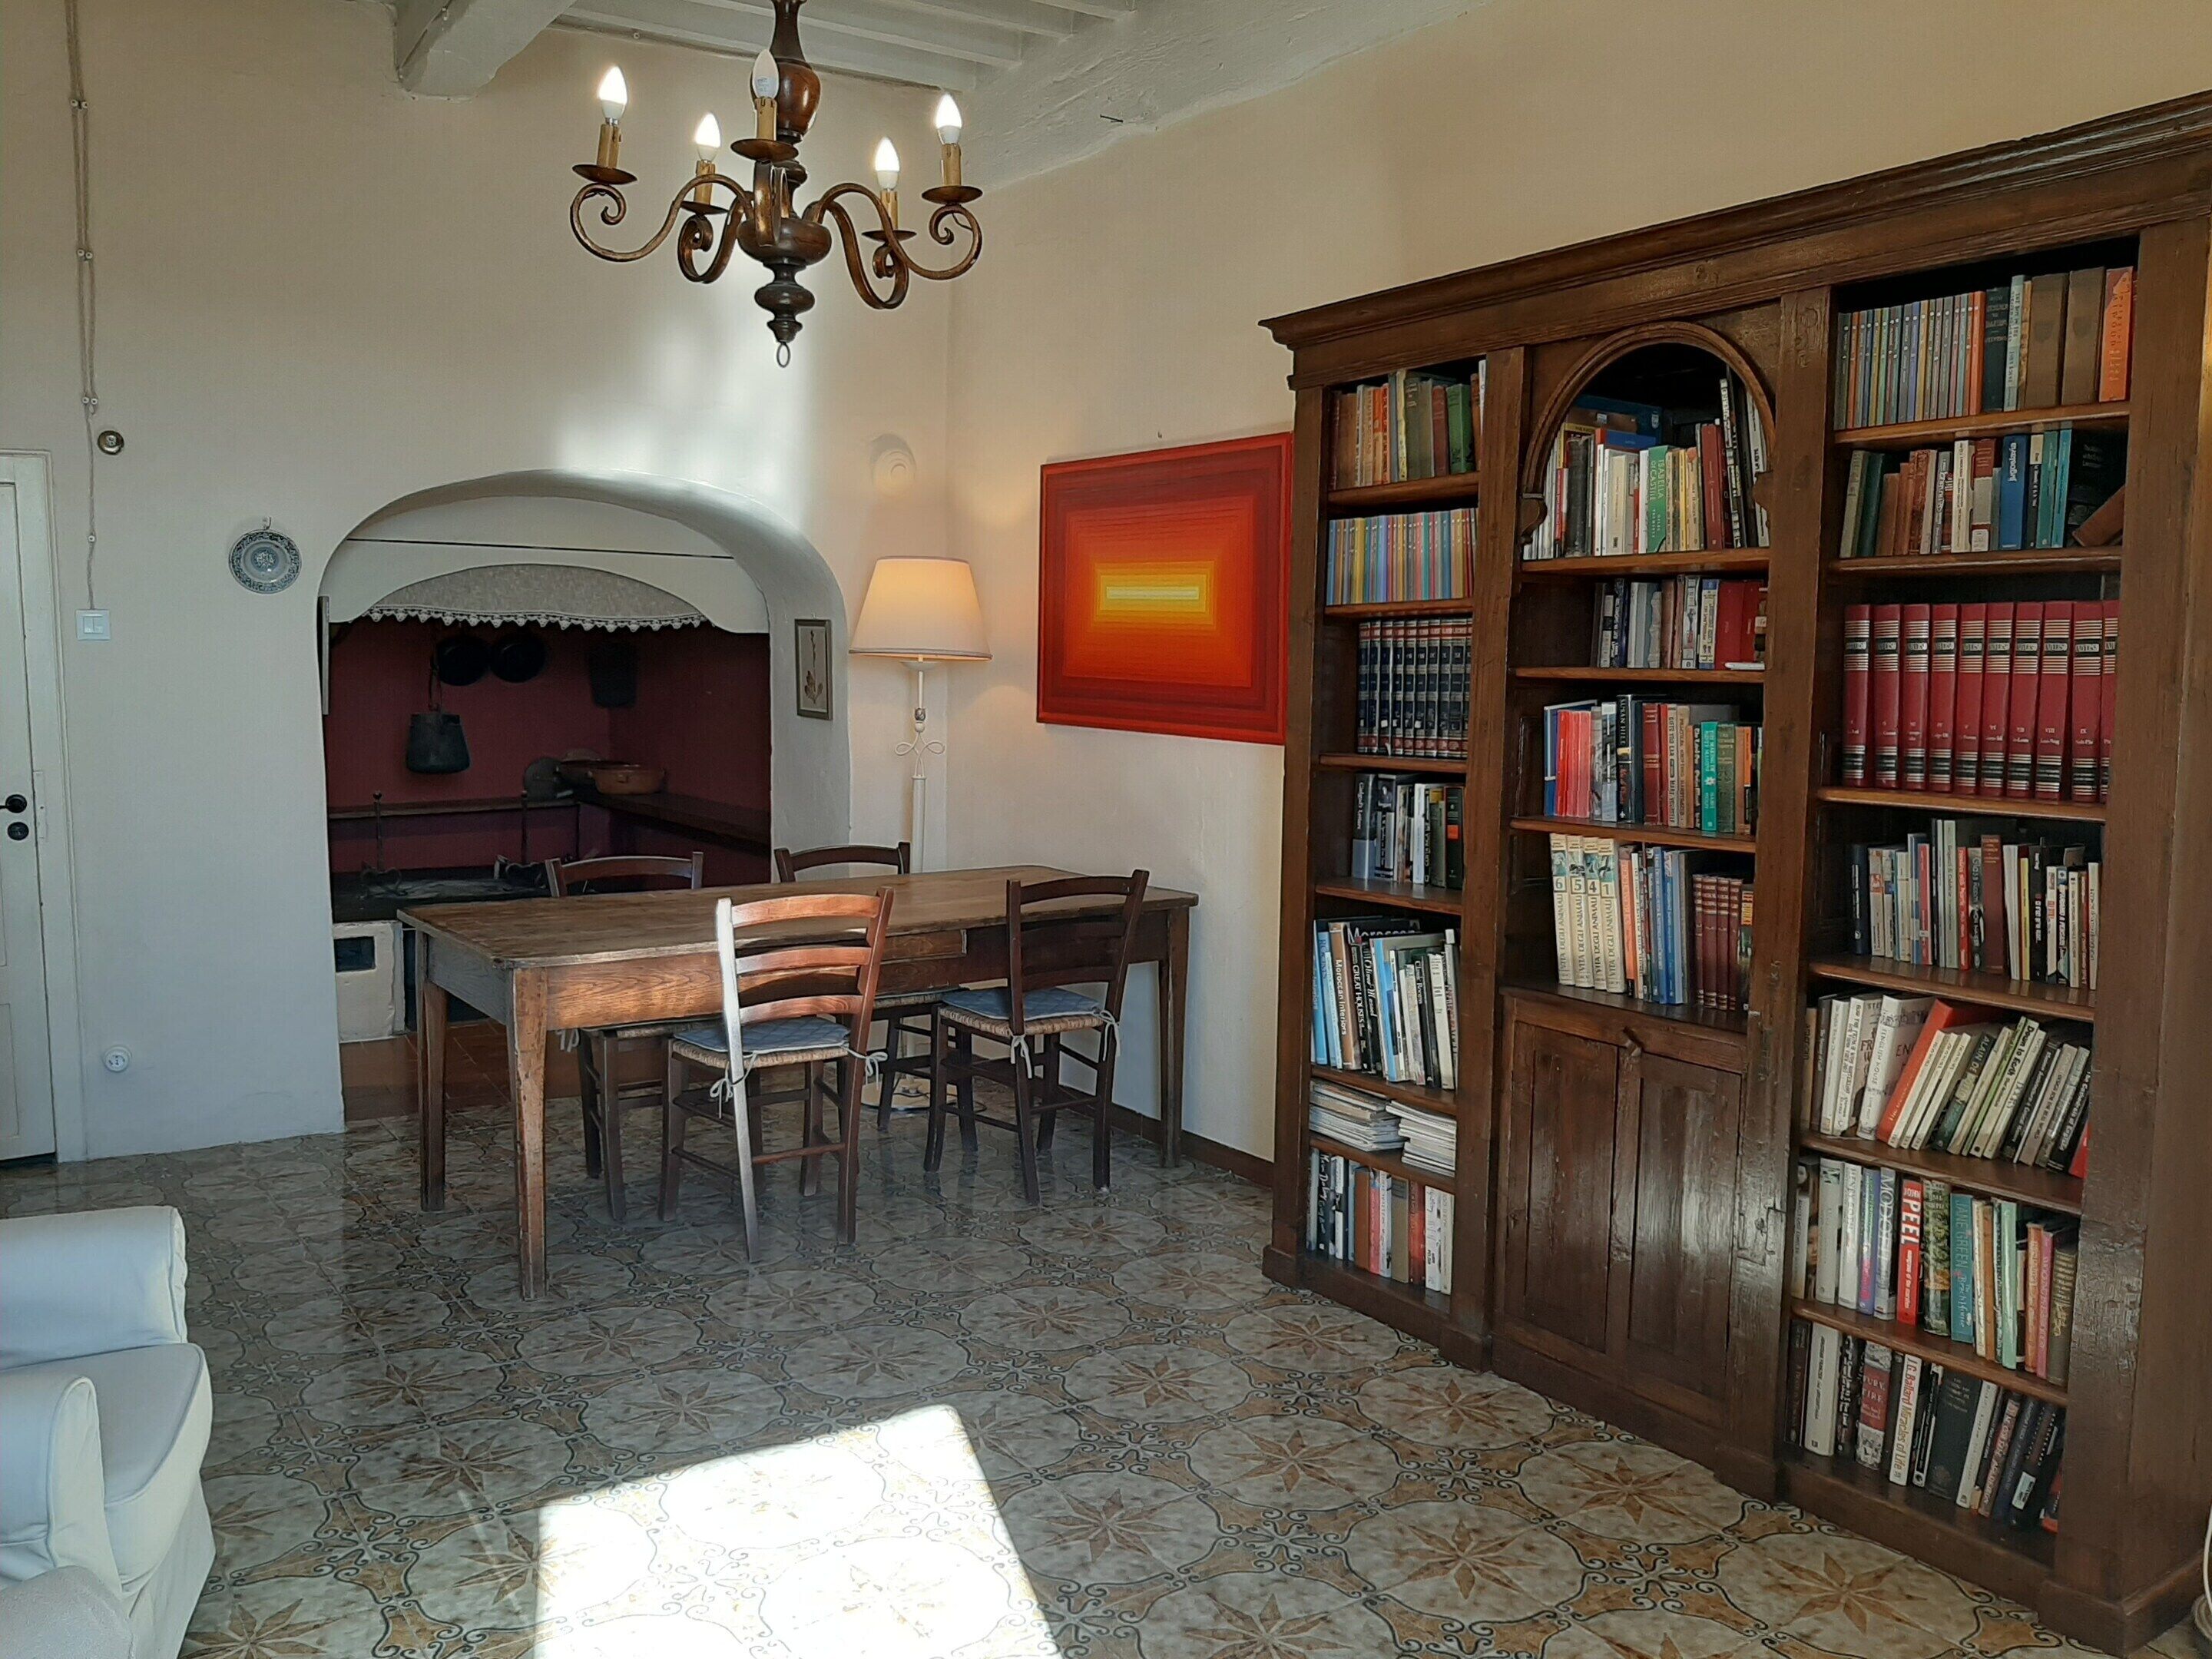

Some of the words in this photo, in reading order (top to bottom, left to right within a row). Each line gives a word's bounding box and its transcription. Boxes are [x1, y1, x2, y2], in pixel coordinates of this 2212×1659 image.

[1555, 876, 1563, 890] 6
[1574, 878, 1582, 891] 5
[1588, 879, 1597, 892] 4
[1602, 883, 1609, 896] 1
[1558, 953, 1566, 969] VITA
[1333, 959, 1346, 998] Moroccan
[1352, 965, 1361, 991] GREAT
[1336, 1000, 1349, 1035] Interiors
[1353, 992, 1364, 1023] HOUSES
[1973, 1035, 1991, 1061] ALAIN
[2019, 1025, 2035, 1048] Down
[2015, 1048, 2025, 1057] to
[1968, 1061, 1979, 1073] DE
[2006, 1056, 2021, 1077] Earth
[1900, 1198, 1921, 1245] PEEL
[1955, 1200, 1968, 1227] JANE
[1954, 1231, 1969, 1268] GREEN
[1901, 1374, 1915, 1406] Ballard
[1897, 1405, 1911, 1442] Miracles
[1896, 1442, 1907, 1453] of
[1893, 1453, 1905, 1470] Life
